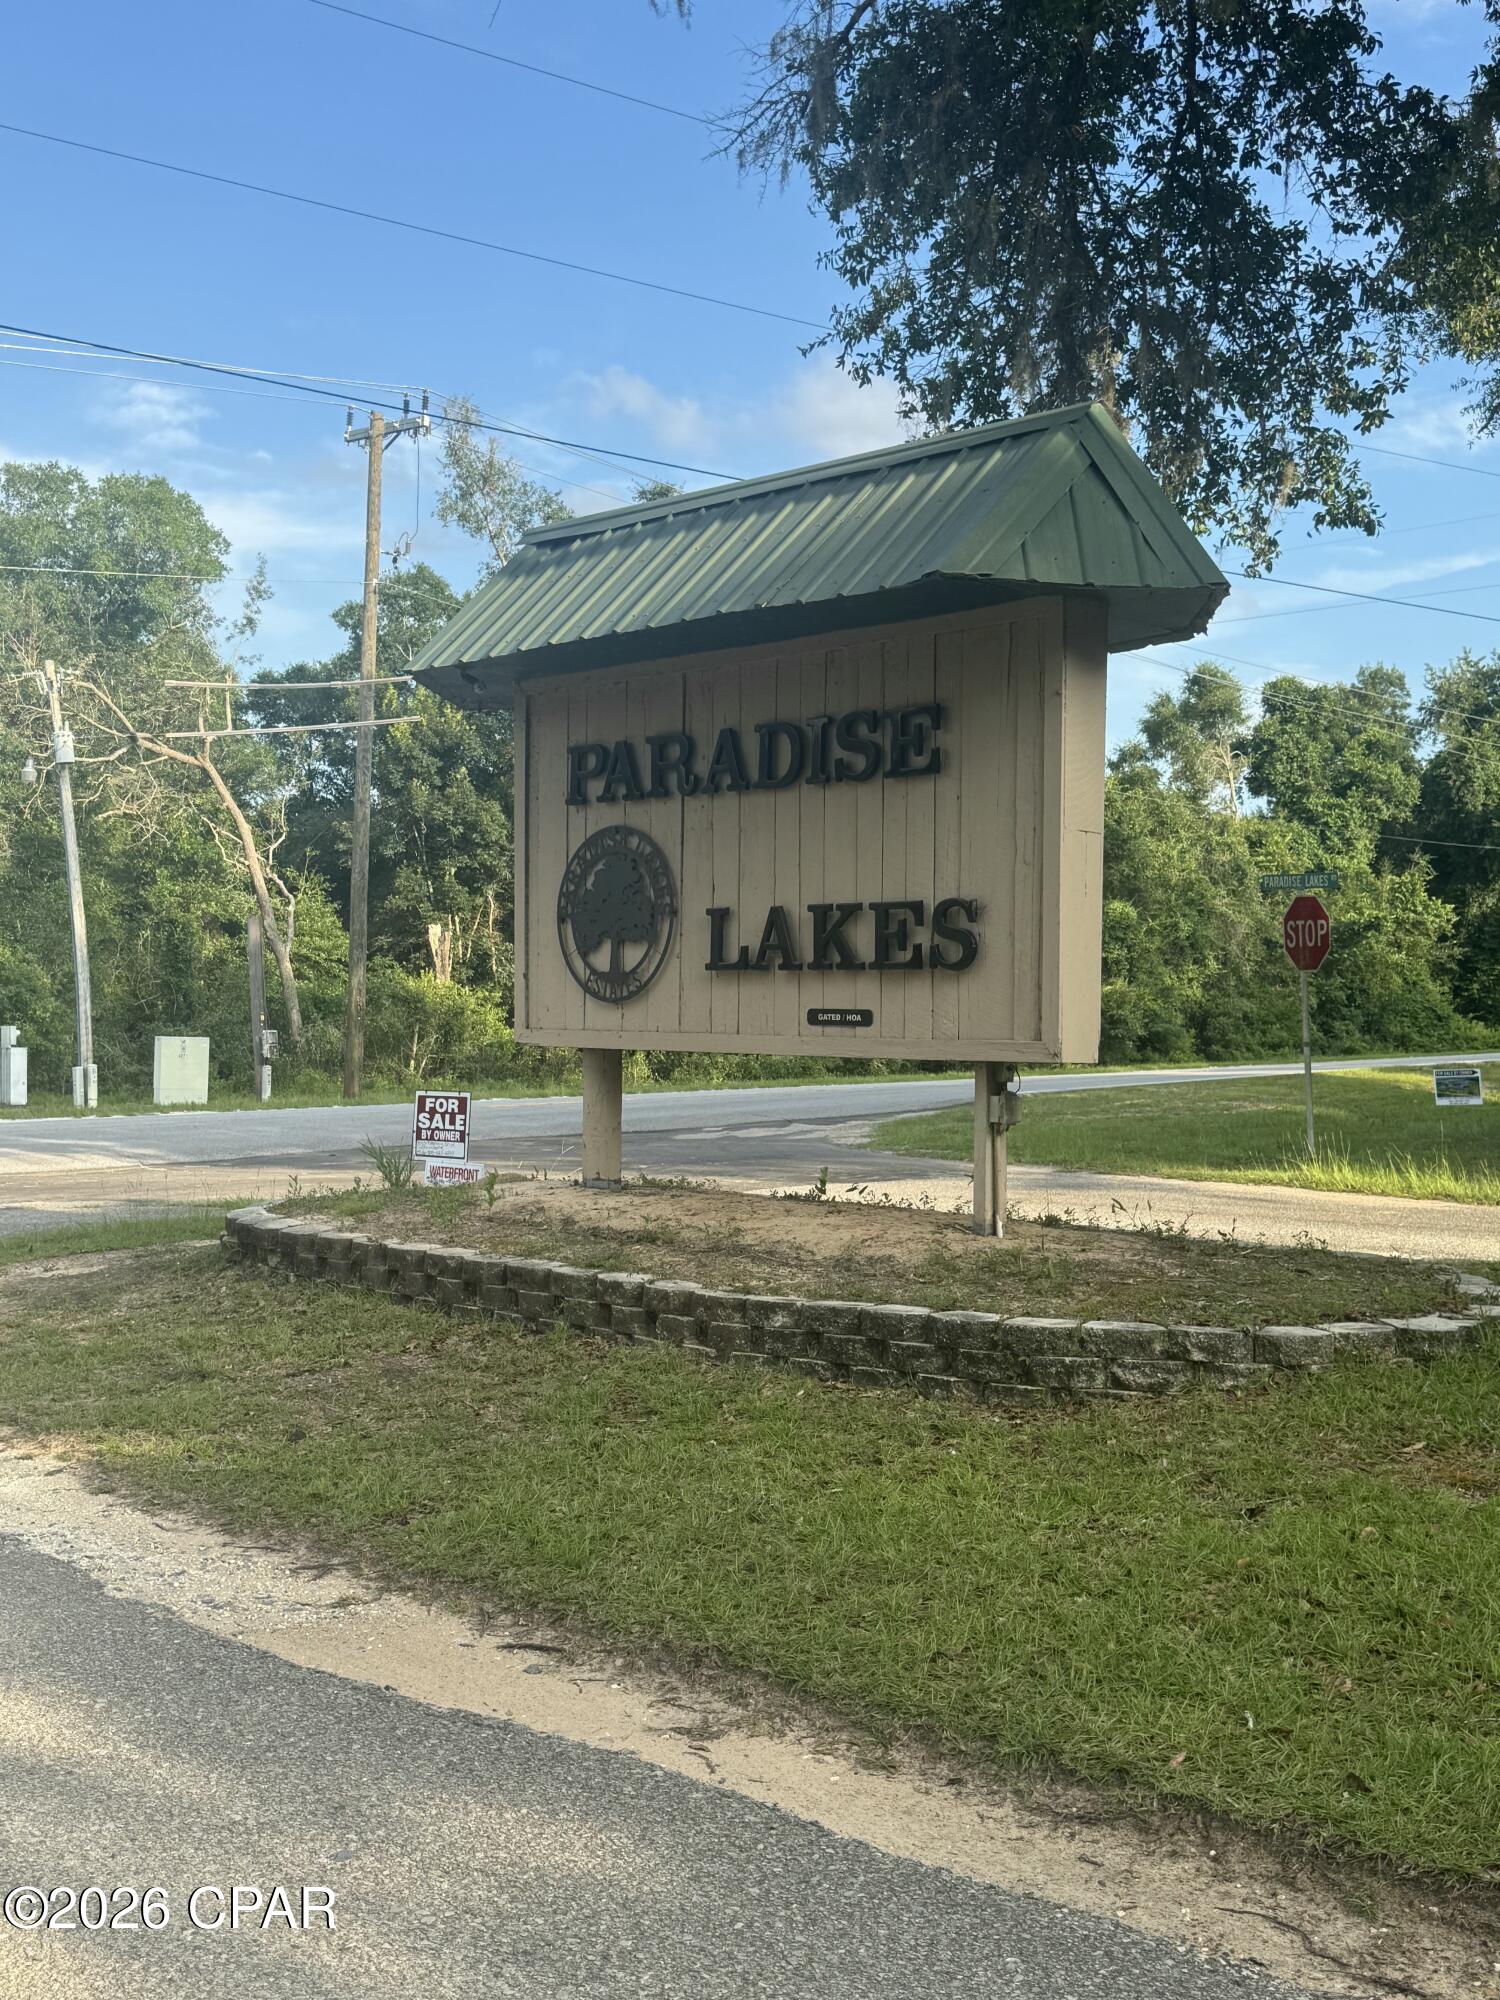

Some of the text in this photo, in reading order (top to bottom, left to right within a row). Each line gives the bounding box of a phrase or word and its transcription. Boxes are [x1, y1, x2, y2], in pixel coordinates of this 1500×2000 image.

[565, 703, 942, 805] PARADISE
[1264, 875, 1301, 888] PARADISE
[1305, 874, 1329, 887] LAKES
[704, 898, 979, 972] LAKES
[1286, 919, 1328, 949] STOP
[585, 971, 642, 999] ESTATES
[846, 1014, 862, 1022] HOA
[425, 1098, 459, 1113] FOR
[417, 1112, 465, 1131] SALE
[421, 1129, 460, 1141] BY OWNER
[429, 1165, 480, 1181] WATERFRONT
